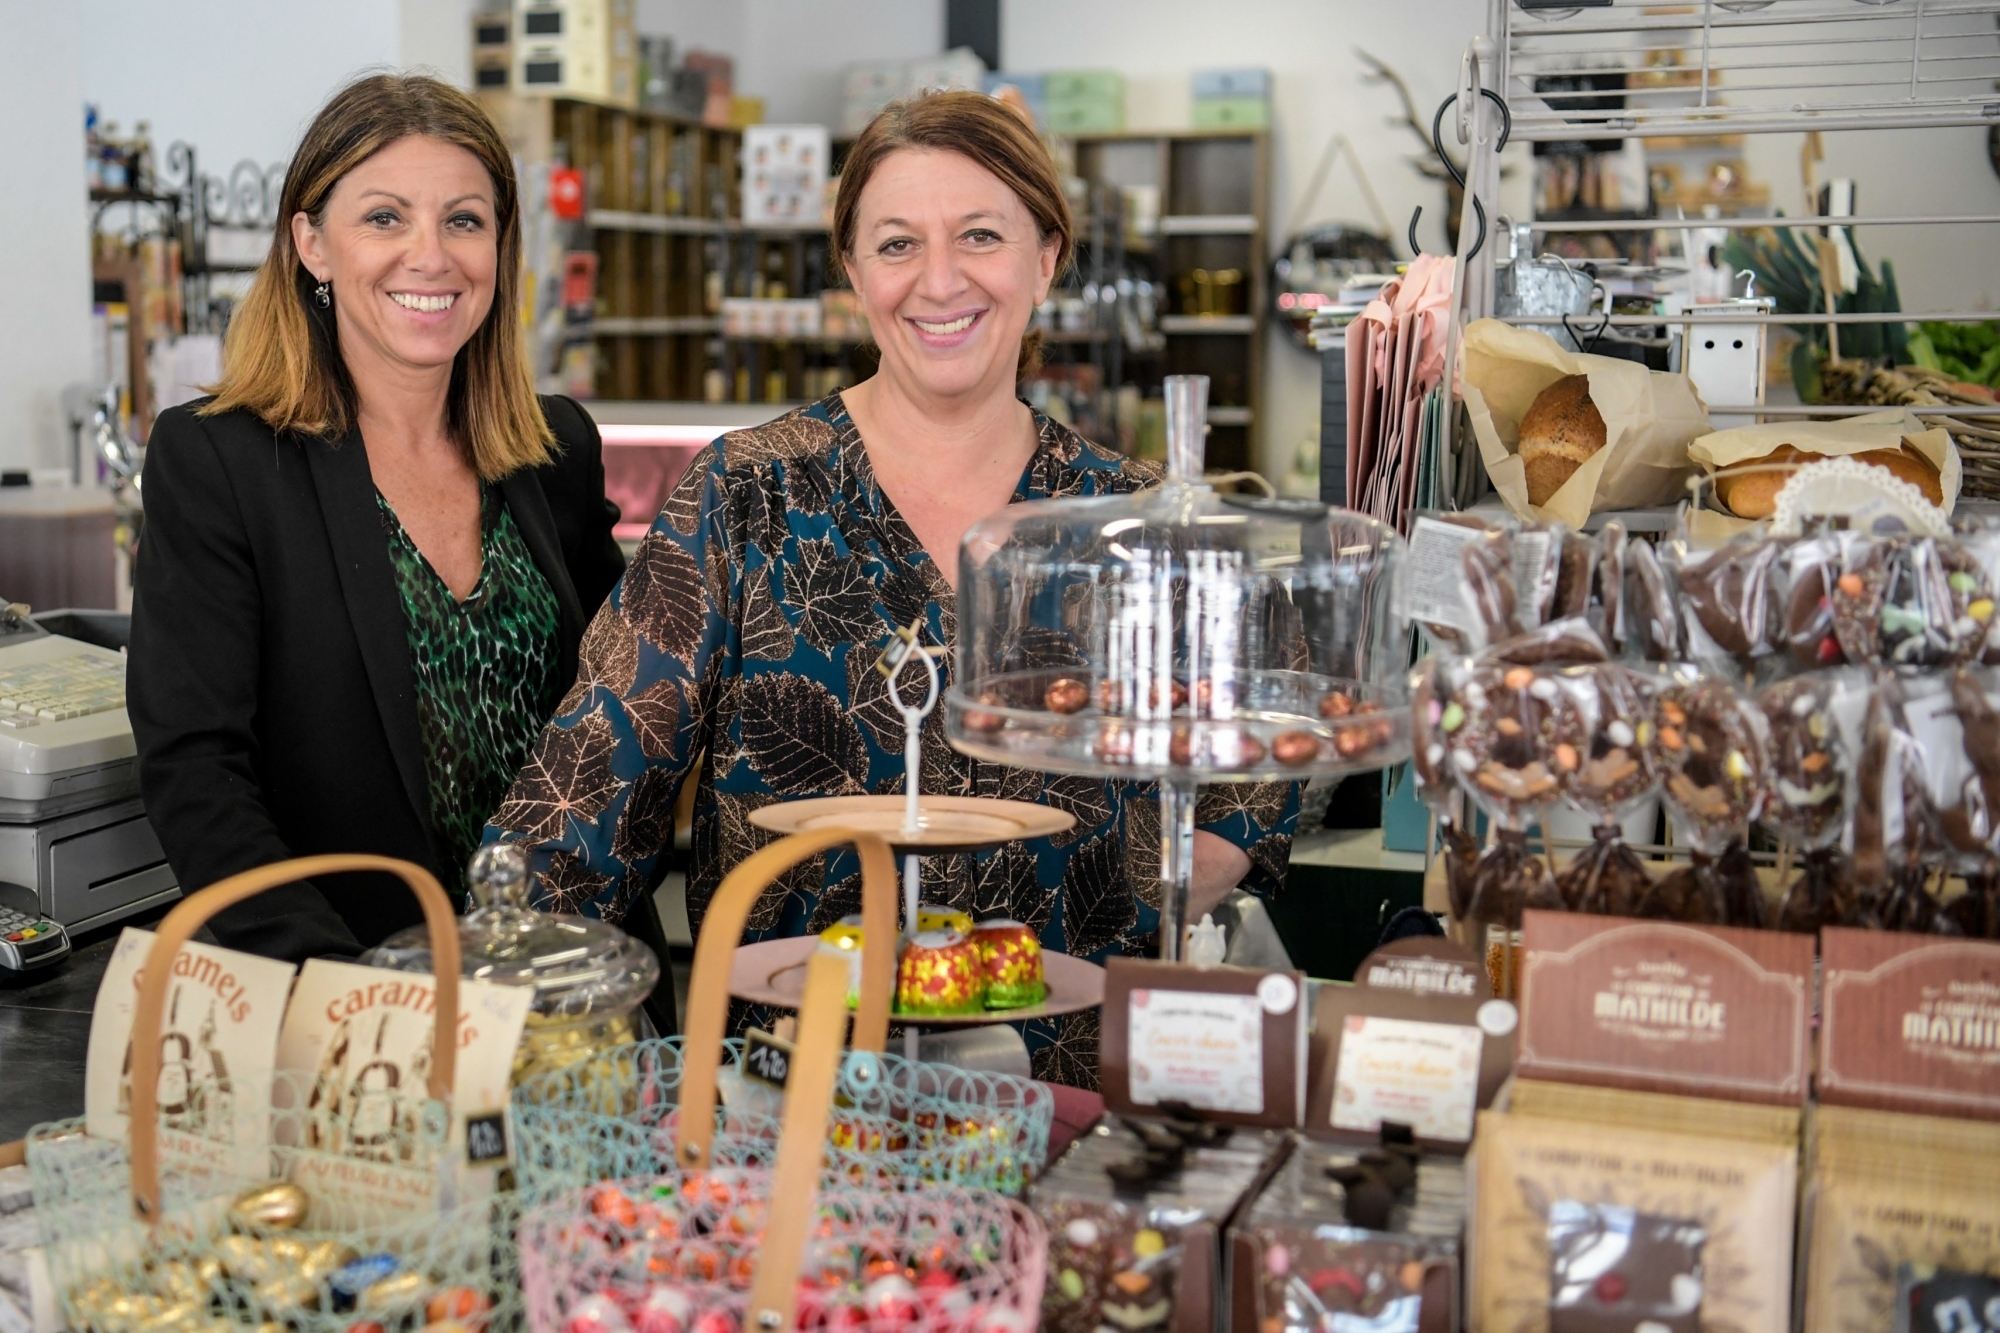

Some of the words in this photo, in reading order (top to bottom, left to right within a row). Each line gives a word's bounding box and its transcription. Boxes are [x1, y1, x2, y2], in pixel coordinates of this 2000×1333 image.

[1368, 965, 1477, 996] MATHILDE
[325, 980, 479, 1050] caramls
[1593, 990, 1727, 1030] MATHILDE
